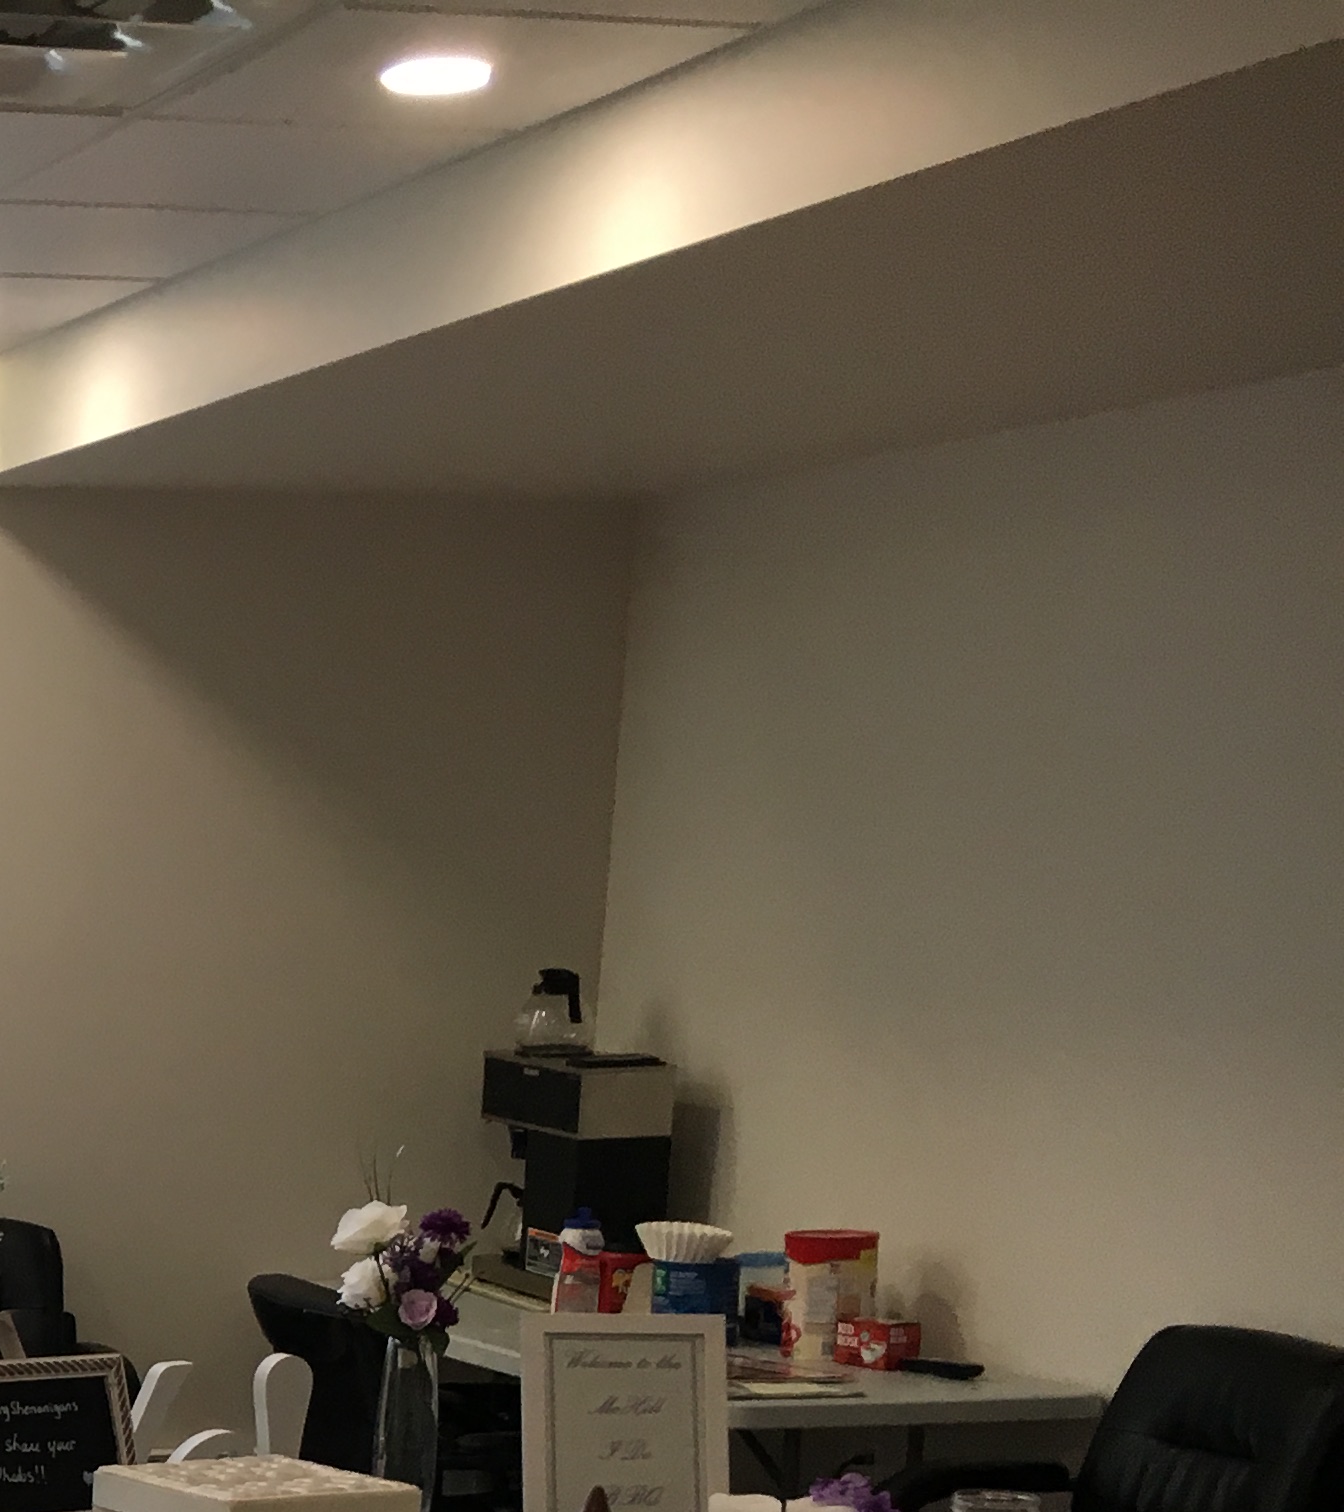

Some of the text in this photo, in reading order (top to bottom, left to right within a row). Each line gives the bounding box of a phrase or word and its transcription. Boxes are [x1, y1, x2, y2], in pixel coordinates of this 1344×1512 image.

[636, 1356, 652, 1369] to
[656, 1353, 683, 1370] the
[5, 1432, 41, 1456] share
[47, 1440, 77, 1459] your
